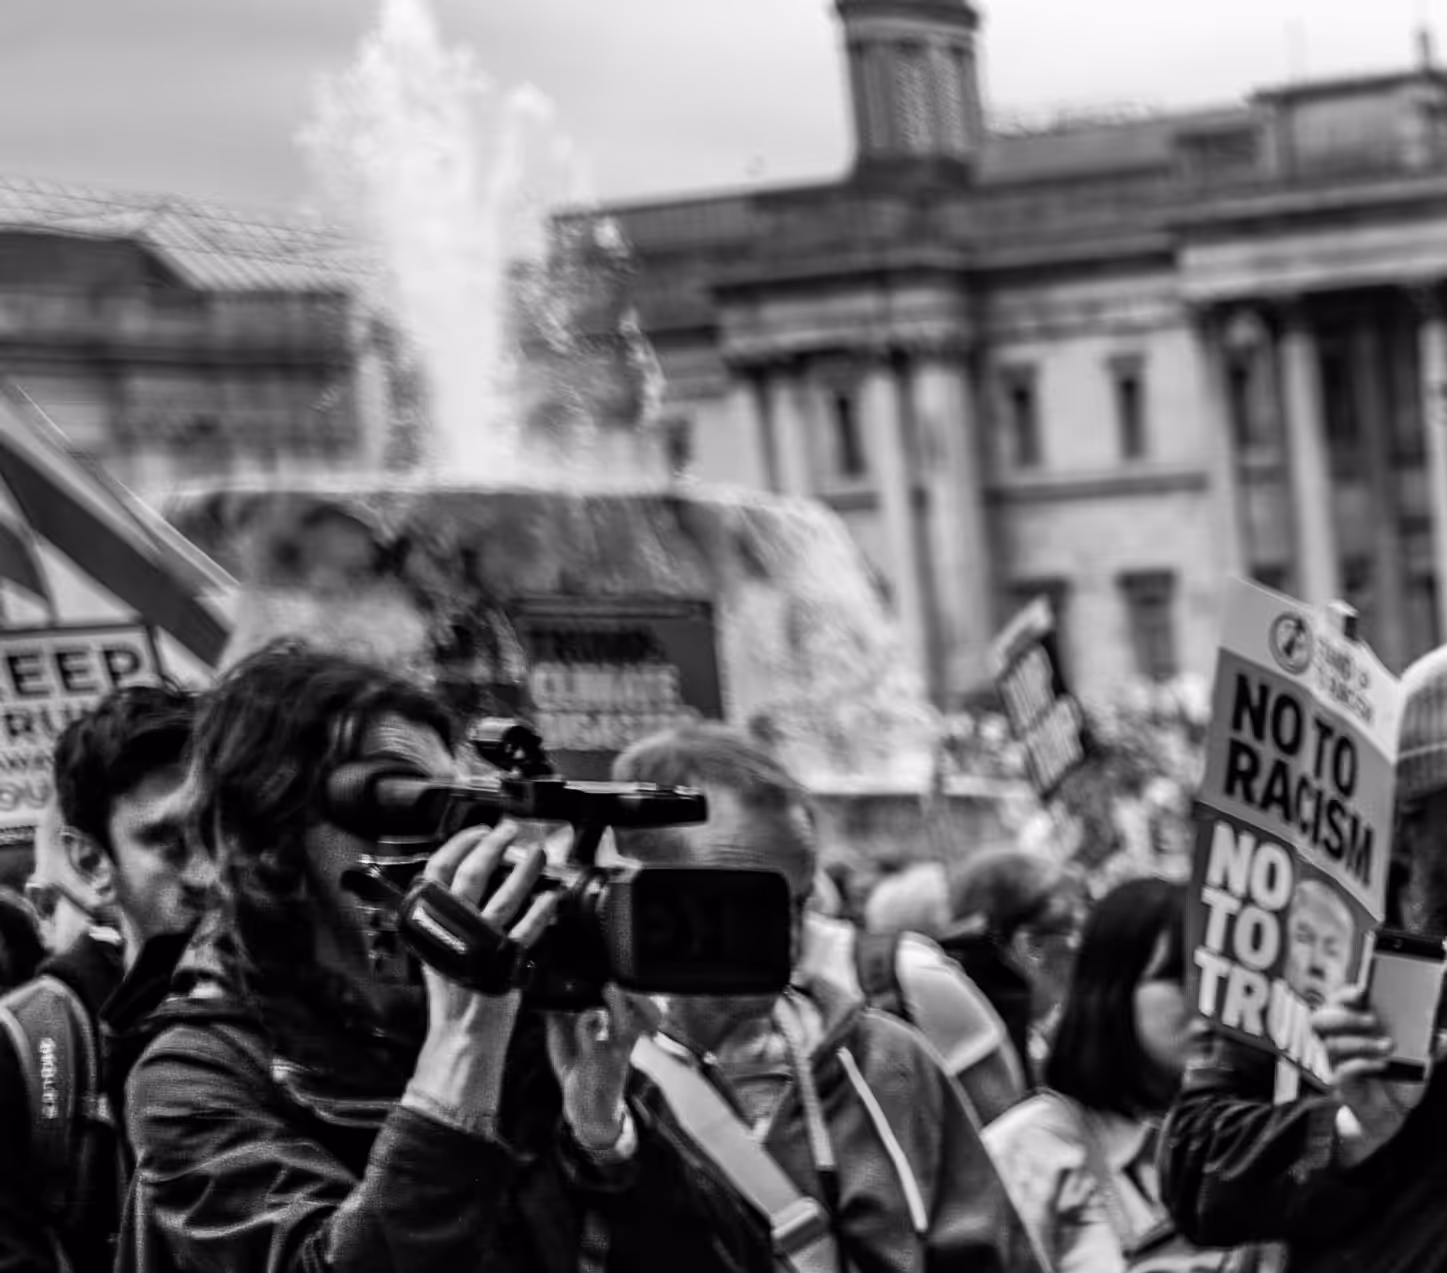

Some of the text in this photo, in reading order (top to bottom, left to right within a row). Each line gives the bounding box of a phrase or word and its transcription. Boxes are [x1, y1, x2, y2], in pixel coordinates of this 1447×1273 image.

[0, 647, 142, 696] EEP
[1231, 672, 1300, 757] NO
[1312, 717, 1359, 798] TO
[1207, 821, 1294, 912] NO
[1224, 738, 1374, 890] RACISM
[1201, 887, 1281, 971] TO
[1195, 946, 1332, 1083] TRUM
